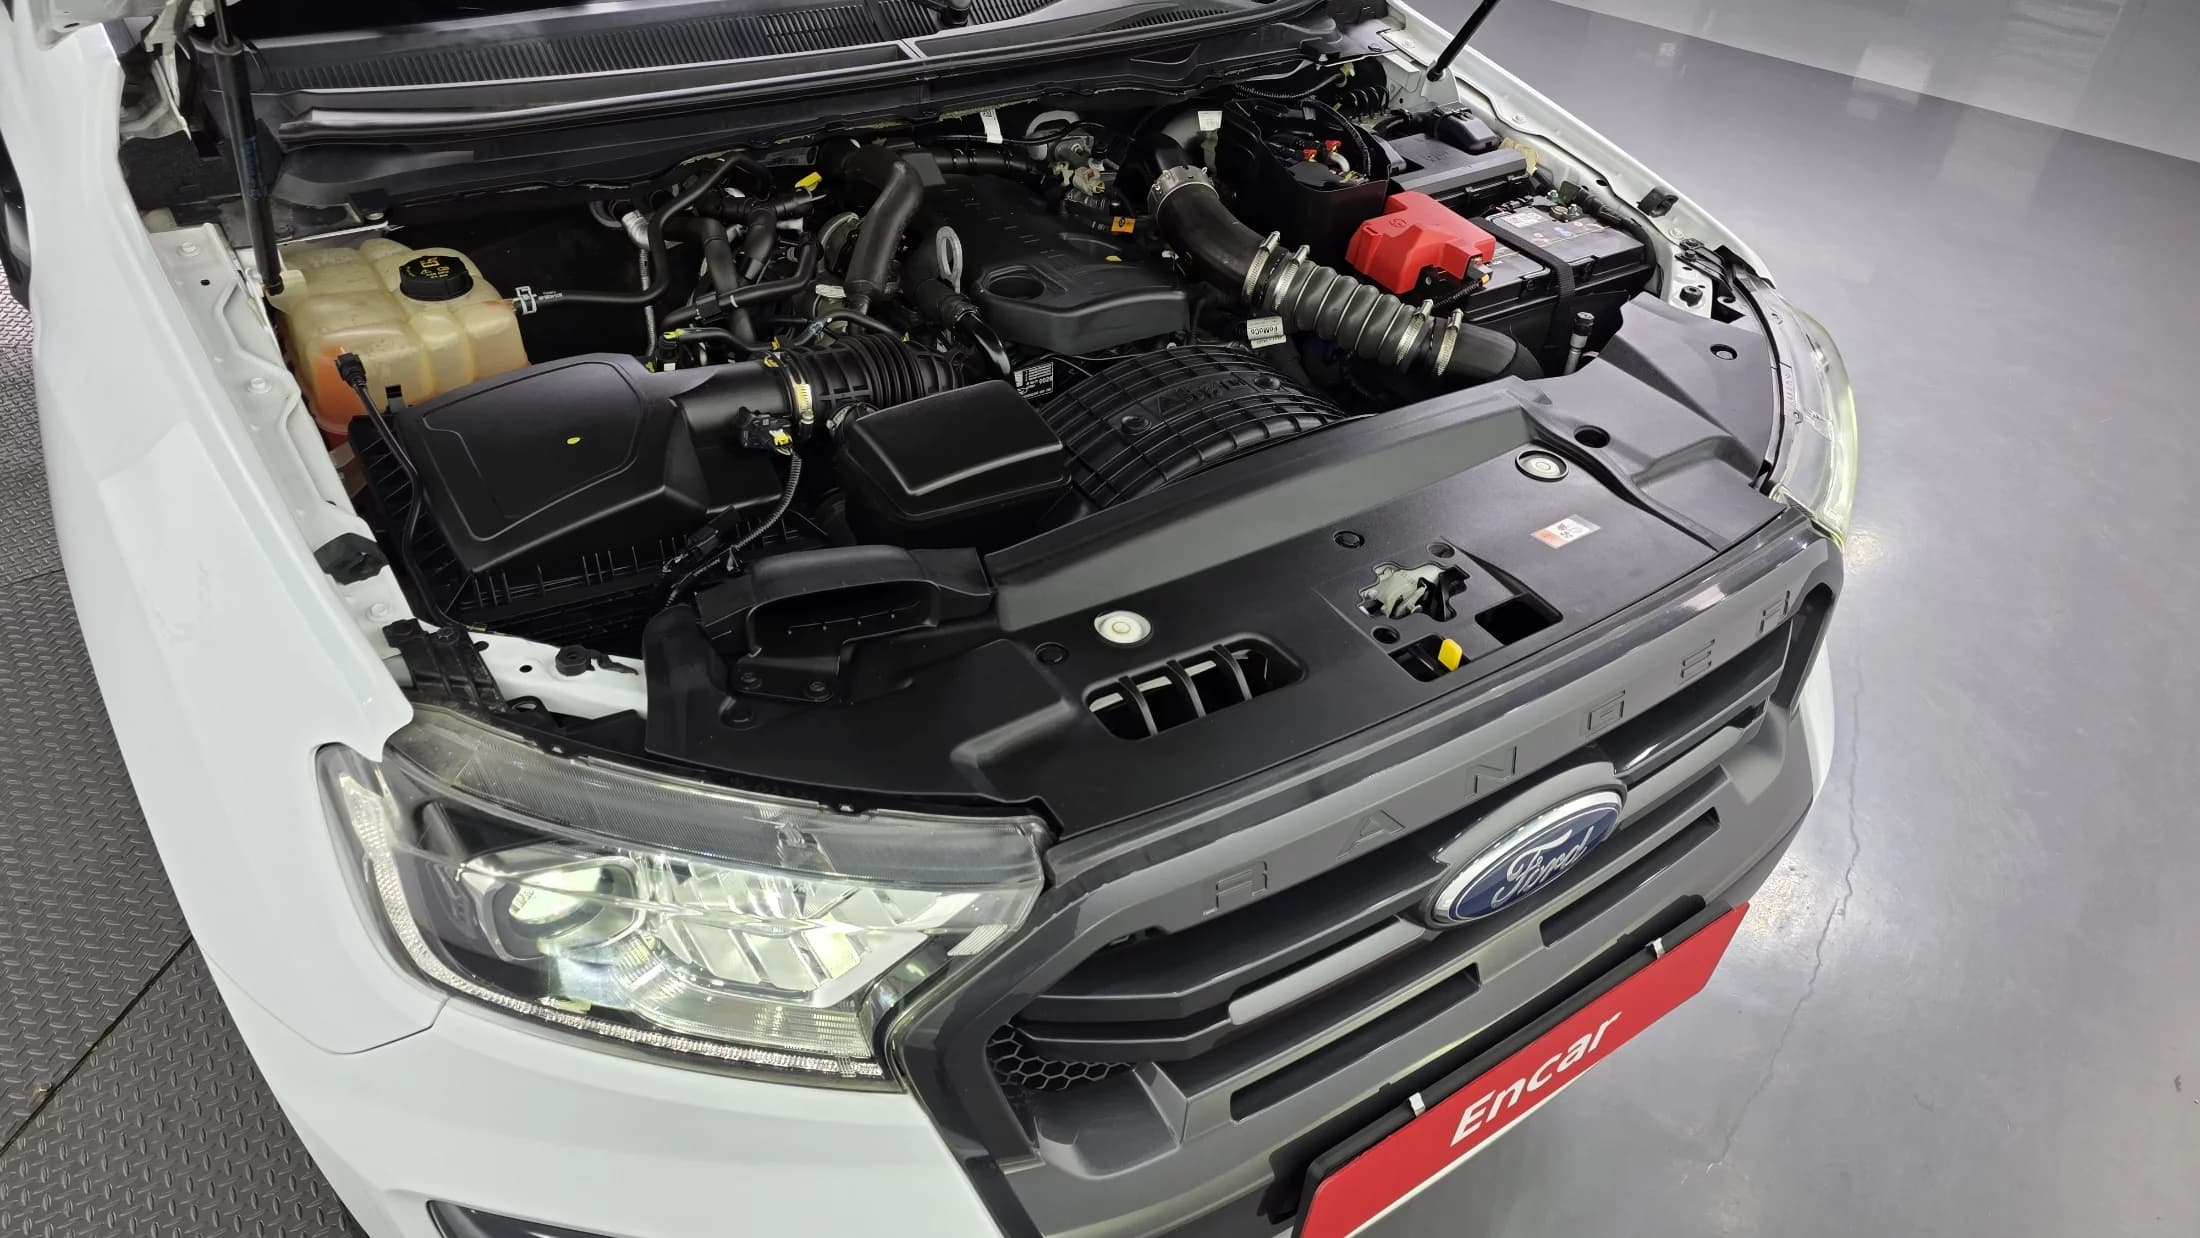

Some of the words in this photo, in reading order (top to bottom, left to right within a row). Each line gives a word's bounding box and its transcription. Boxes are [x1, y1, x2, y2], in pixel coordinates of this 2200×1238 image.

[1202, 590, 1791, 916] RANGER
[1491, 825, 1592, 903] Ford
[1449, 1010, 1623, 1148] Encar
